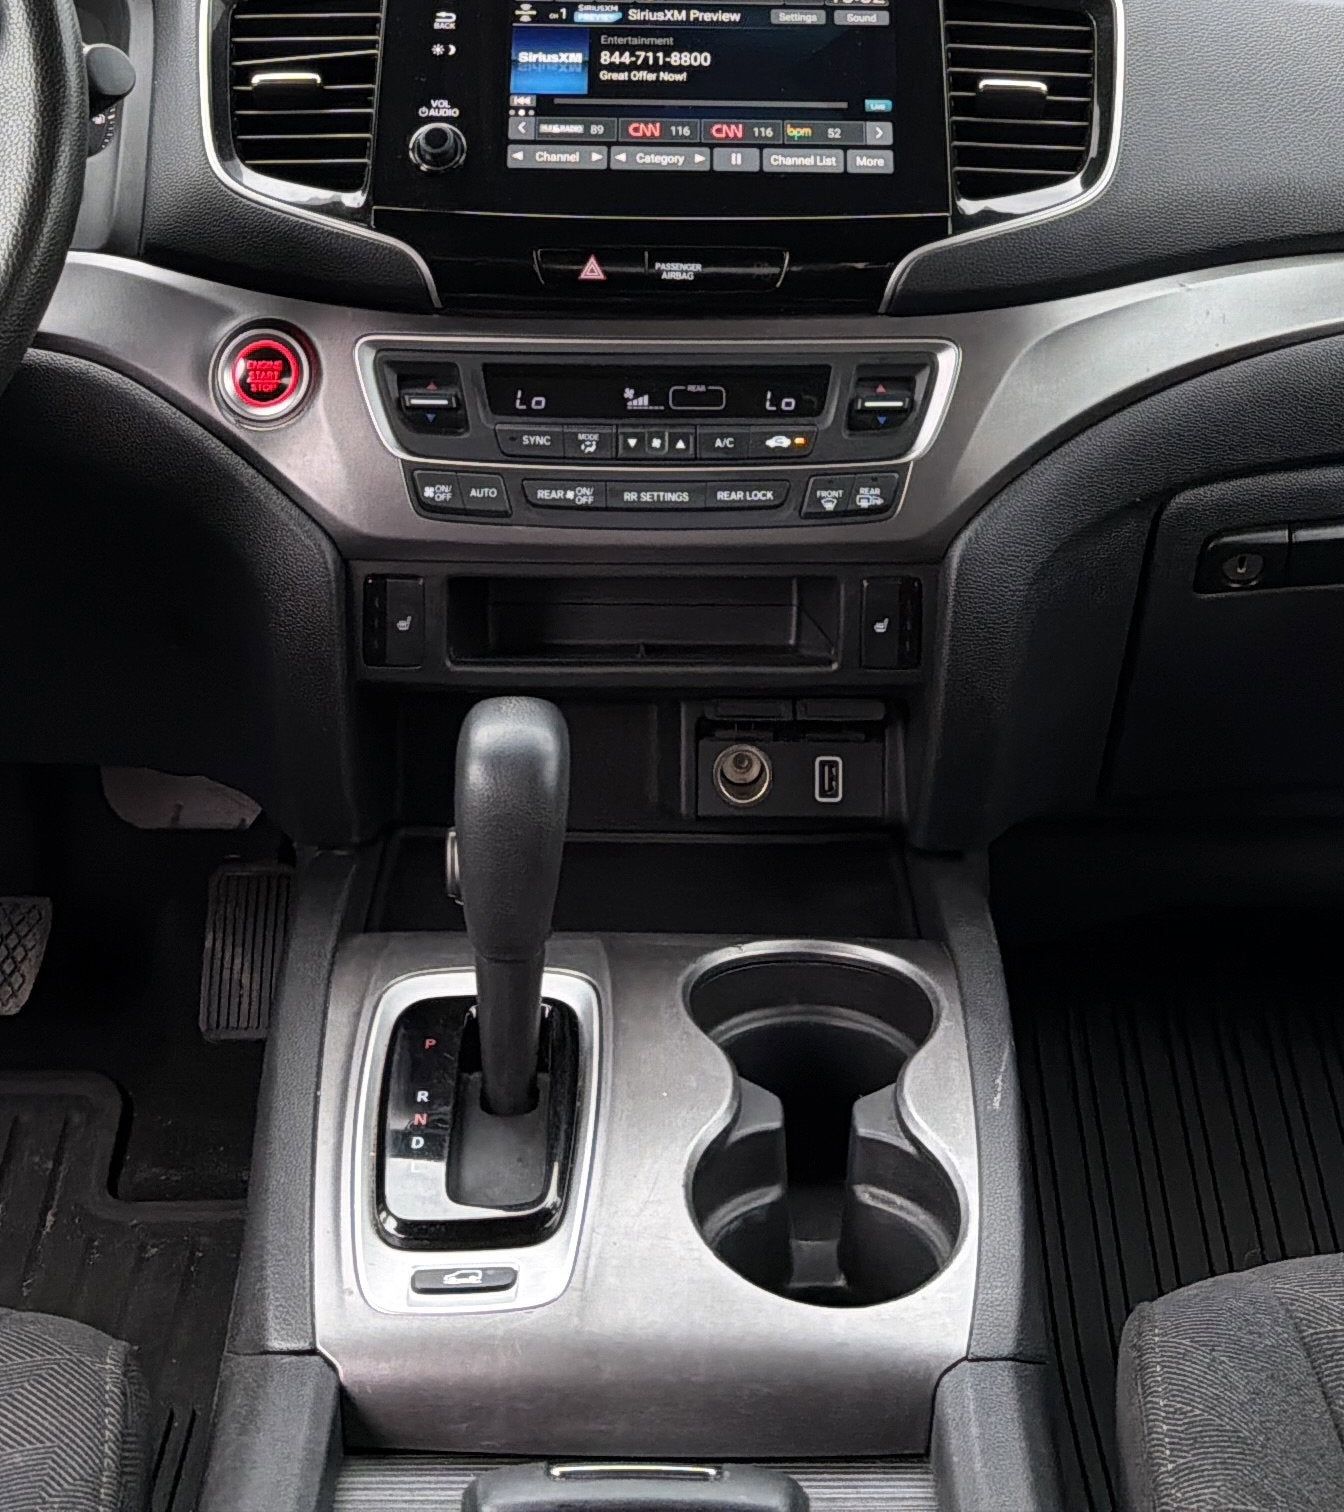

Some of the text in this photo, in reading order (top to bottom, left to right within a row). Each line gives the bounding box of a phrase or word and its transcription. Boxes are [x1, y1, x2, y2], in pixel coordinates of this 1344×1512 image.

[560, 7, 567, 19] 1
[627, 8, 741, 22] SiriusXM Preview
[778, 12, 818, 23] Settings
[846, 13, 877, 23] Sound
[433, 22, 456, 30] BACK
[600, 35, 675, 46] Entertainment
[518, 51, 583, 64] SiriusXM
[600, 51, 711, 67] 844-711-8800
[599, 71, 687, 82] Great Offer Now!
[431, 100, 451, 109] VOL
[428, 108, 460, 117] AUDIO
[590, 125, 604, 135] 89
[628, 122, 661, 137] CNN
[670, 126, 691, 136] 116
[711, 123, 743, 138] CNN
[753, 127, 774, 137] 116
[786, 124, 812, 140] bpm
[827, 128, 842, 139] 52
[535, 151, 580, 163] Channel
[636, 152, 685, 166] Category
[770, 155, 837, 166] Channel List
[856, 156, 885, 167] More
[655, 262, 702, 271] PASSENGER
[661, 271, 695, 280] AIRBAG
[247, 360, 283, 370] ENGINE
[248, 370, 280, 380] START
[251, 383, 278, 393] STOP
[687, 384, 707, 392] REAR
[522, 435, 552, 446] SYNC
[577, 433, 600, 441] MODE
[714, 437, 735, 448] A/C
[434, 484, 453, 493] ON/
[469, 488, 498, 498] AUTO
[575, 486, 594, 496] ON/
[816, 490, 845, 498] FRONT
[859, 487, 881, 495] REAR
[434, 493, 453, 502] OFF
[536, 489, 565, 500] REAR
[623, 491, 689, 502] RR SETTINGS
[716, 490, 774, 501] REAR LOCK
[575, 496, 594, 505] OFF
[424, 1038, 437, 1049] P
[416, 1090, 430, 1103] R
[414, 1114, 428, 1126] N
[411, 1137, 425, 1150] D
